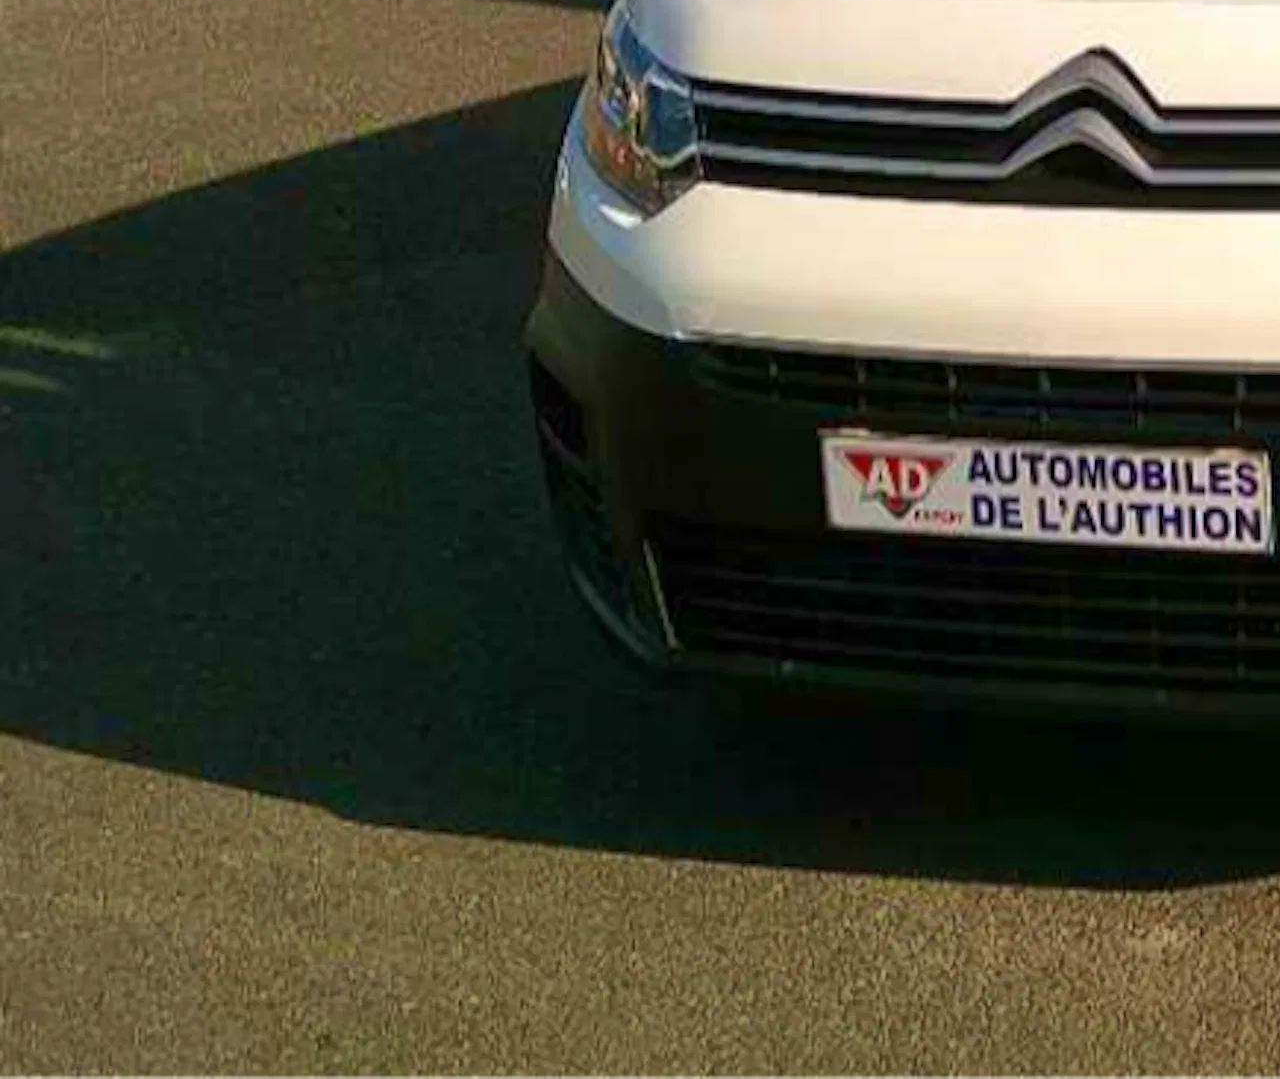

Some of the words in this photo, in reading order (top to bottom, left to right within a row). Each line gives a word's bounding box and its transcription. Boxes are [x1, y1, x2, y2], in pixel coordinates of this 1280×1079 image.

[866, 456, 931, 498] AD
[968, 448, 1260, 498] AUTOMOBILES
[971, 493, 1023, 530] DE
[1037, 496, 1262, 542] L'AUTHION
